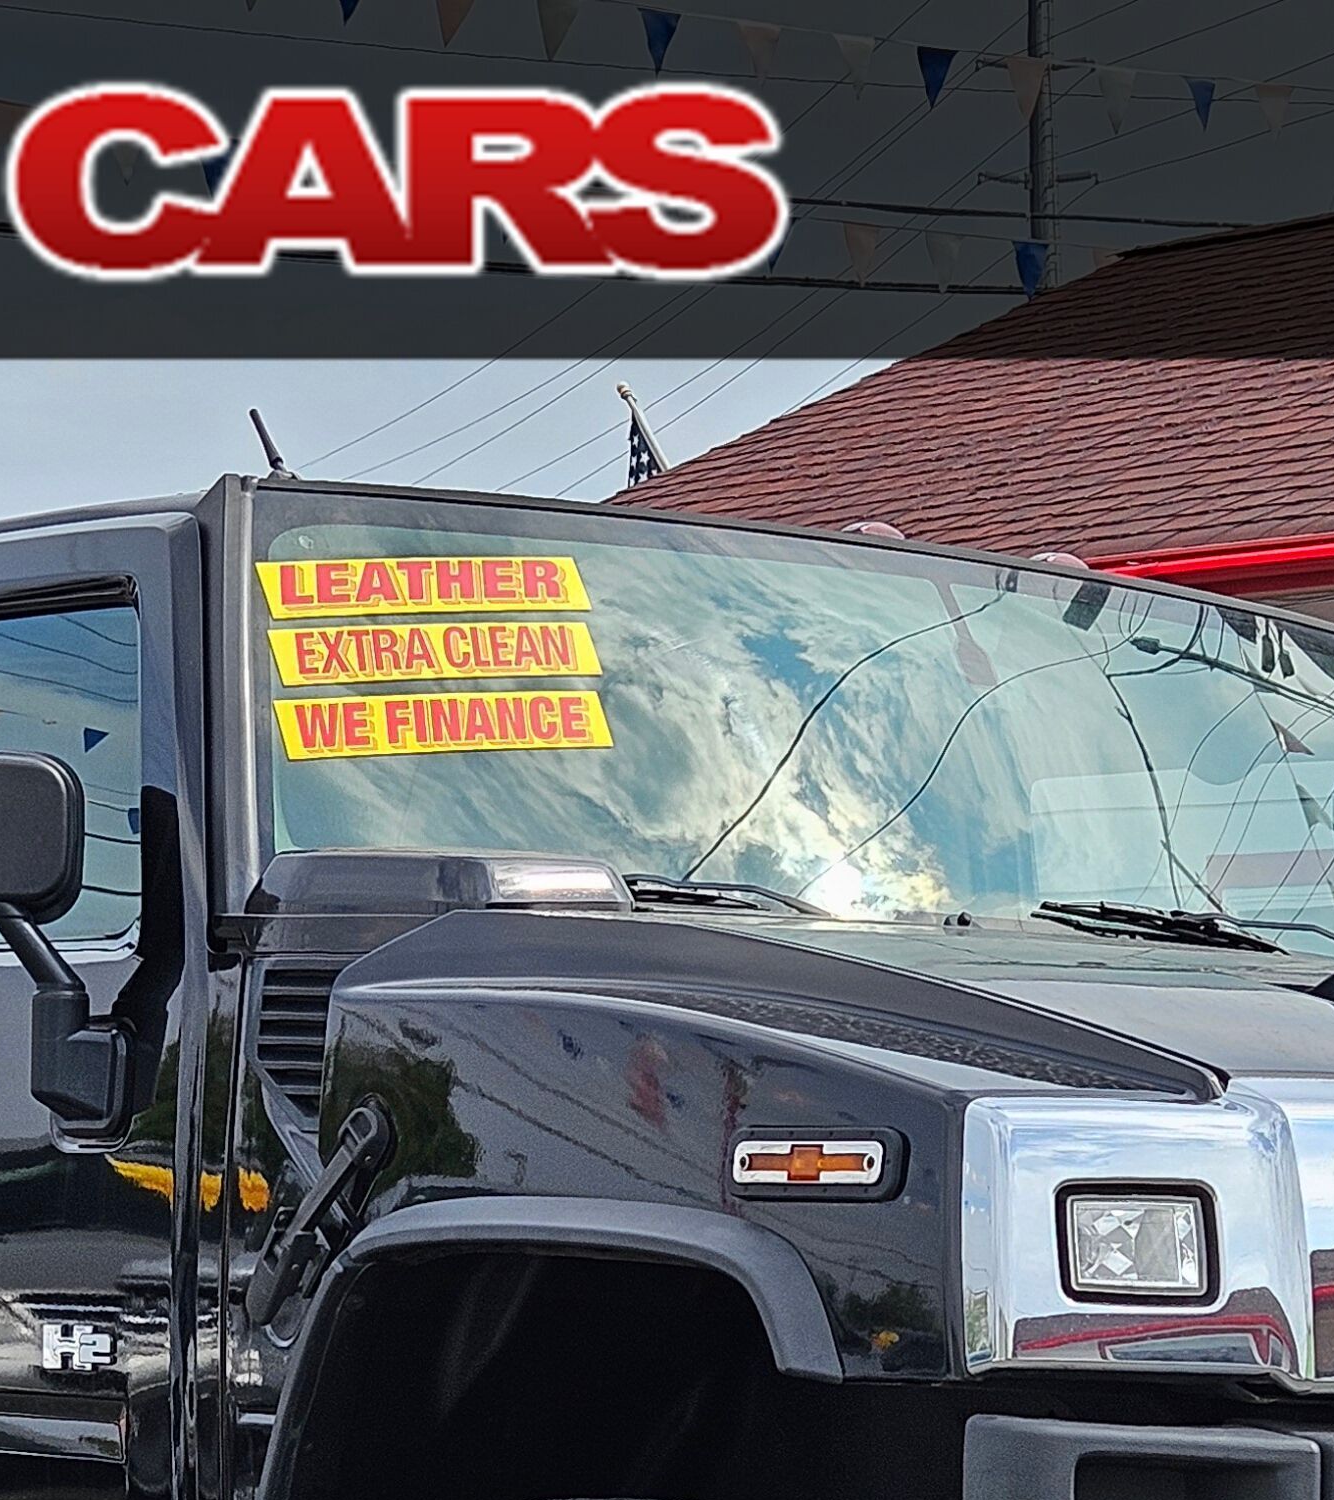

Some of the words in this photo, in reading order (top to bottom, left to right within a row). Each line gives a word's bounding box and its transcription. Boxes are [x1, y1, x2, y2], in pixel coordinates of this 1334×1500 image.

[279, 559, 567, 610] LEATHER
[294, 627, 439, 679] EXTRA
[442, 624, 578, 671] CLEAN
[295, 702, 376, 753] WE
[384, 696, 591, 746] FINANCE
[42, 1323, 115, 1372] H2
